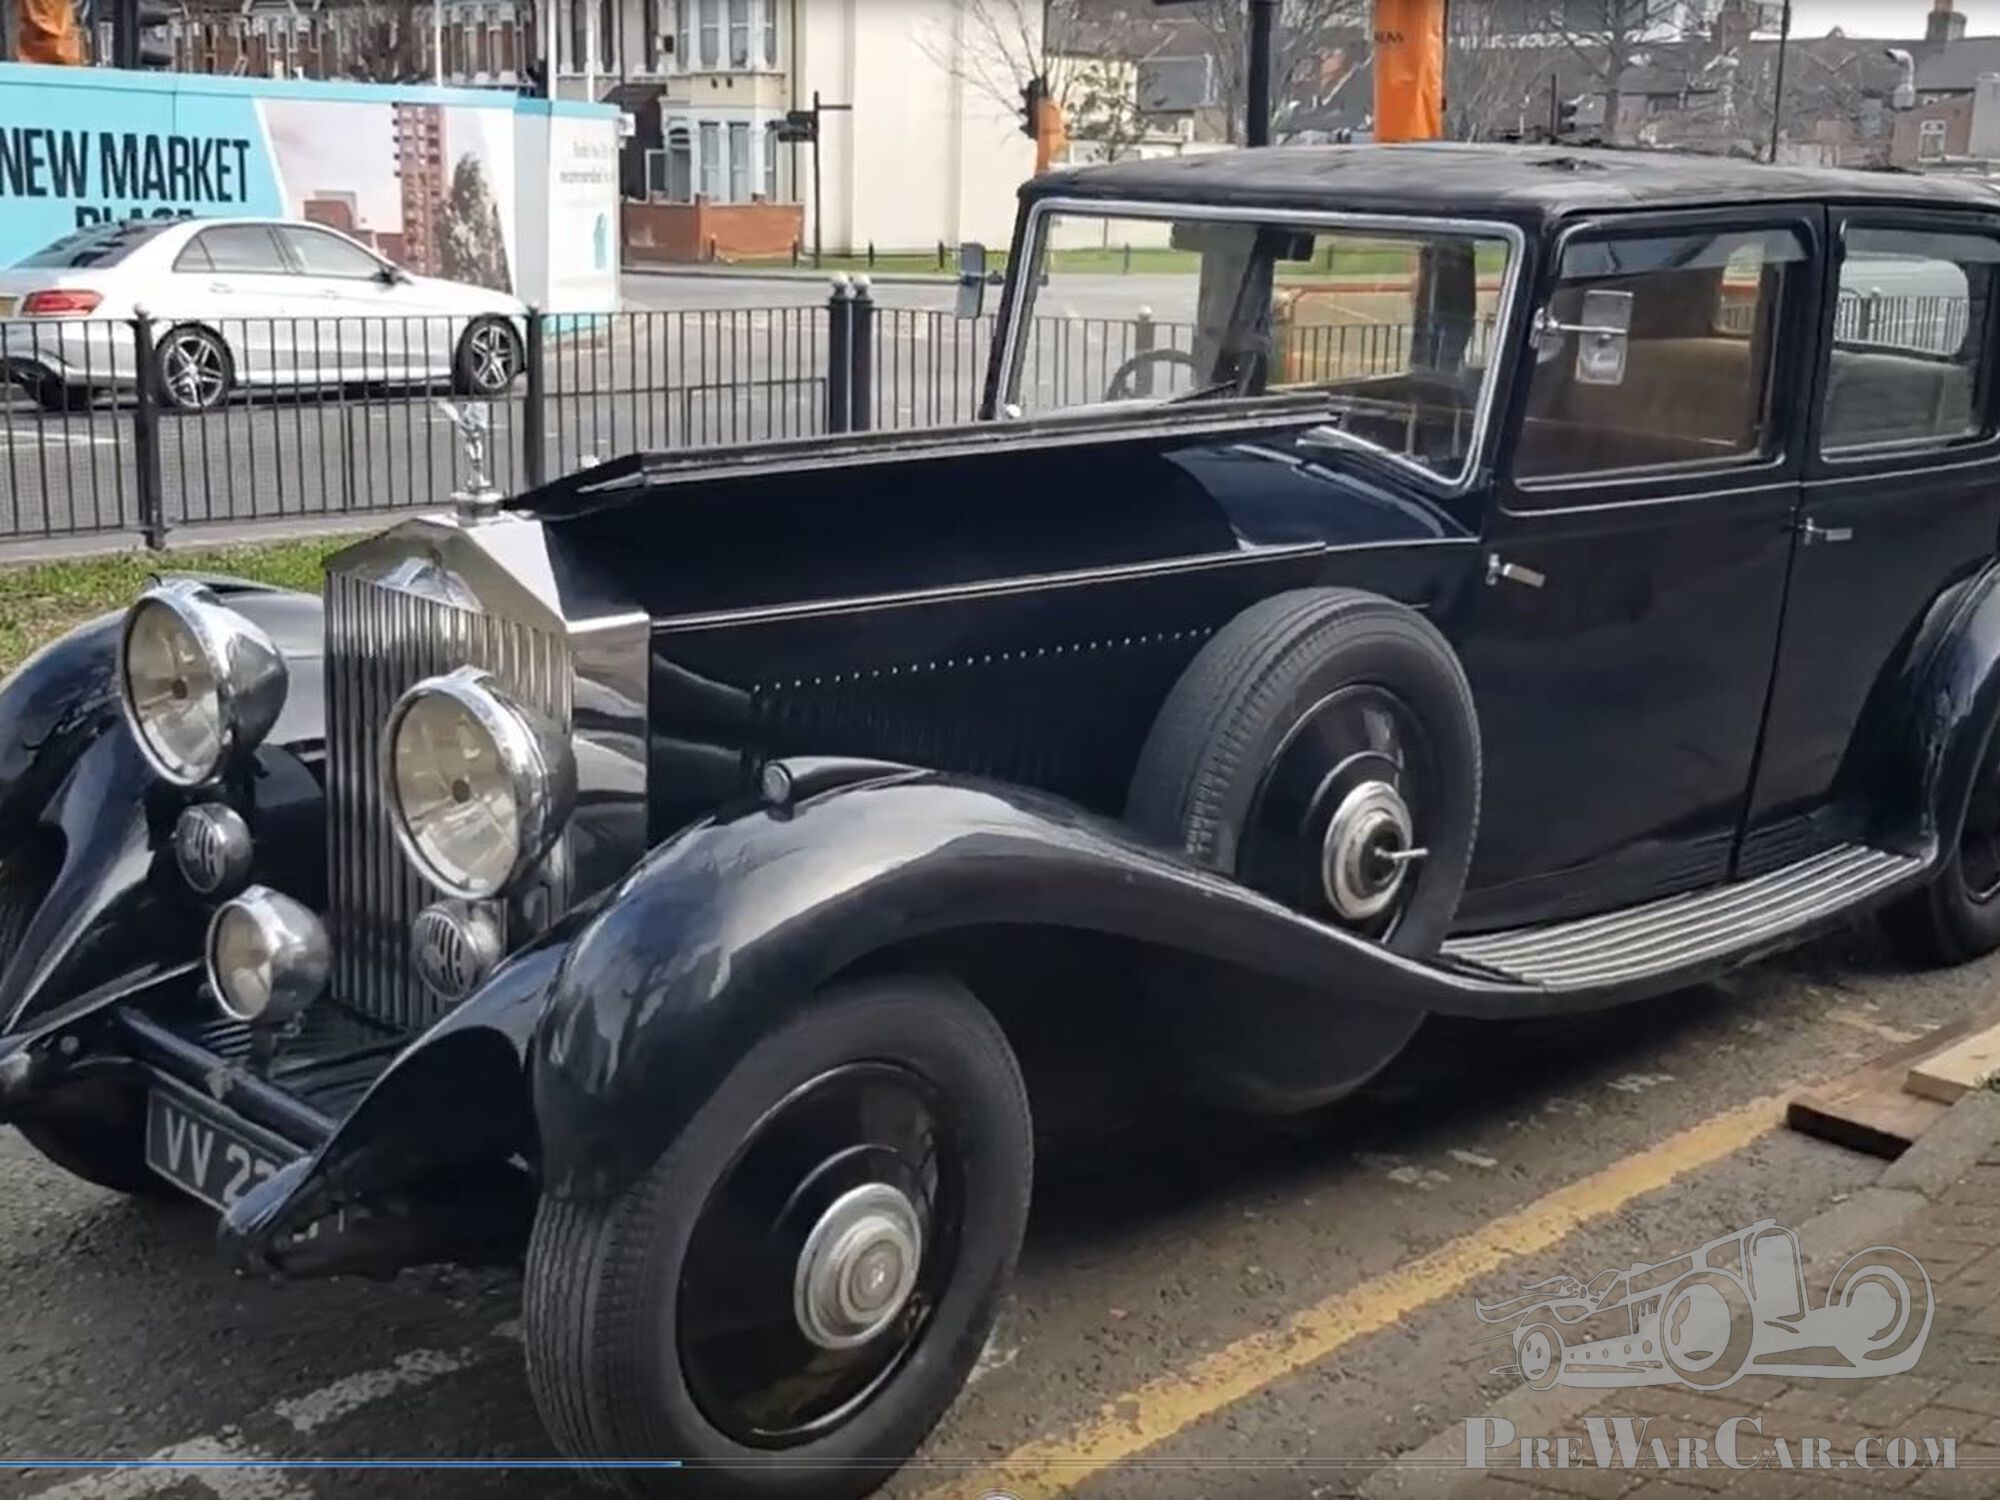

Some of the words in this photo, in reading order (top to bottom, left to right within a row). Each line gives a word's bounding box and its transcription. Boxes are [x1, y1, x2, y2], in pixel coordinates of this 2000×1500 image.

[0, 127, 89, 198] NEW
[99, 132, 250, 202] MARKET
[165, 1107, 214, 1188] VV
